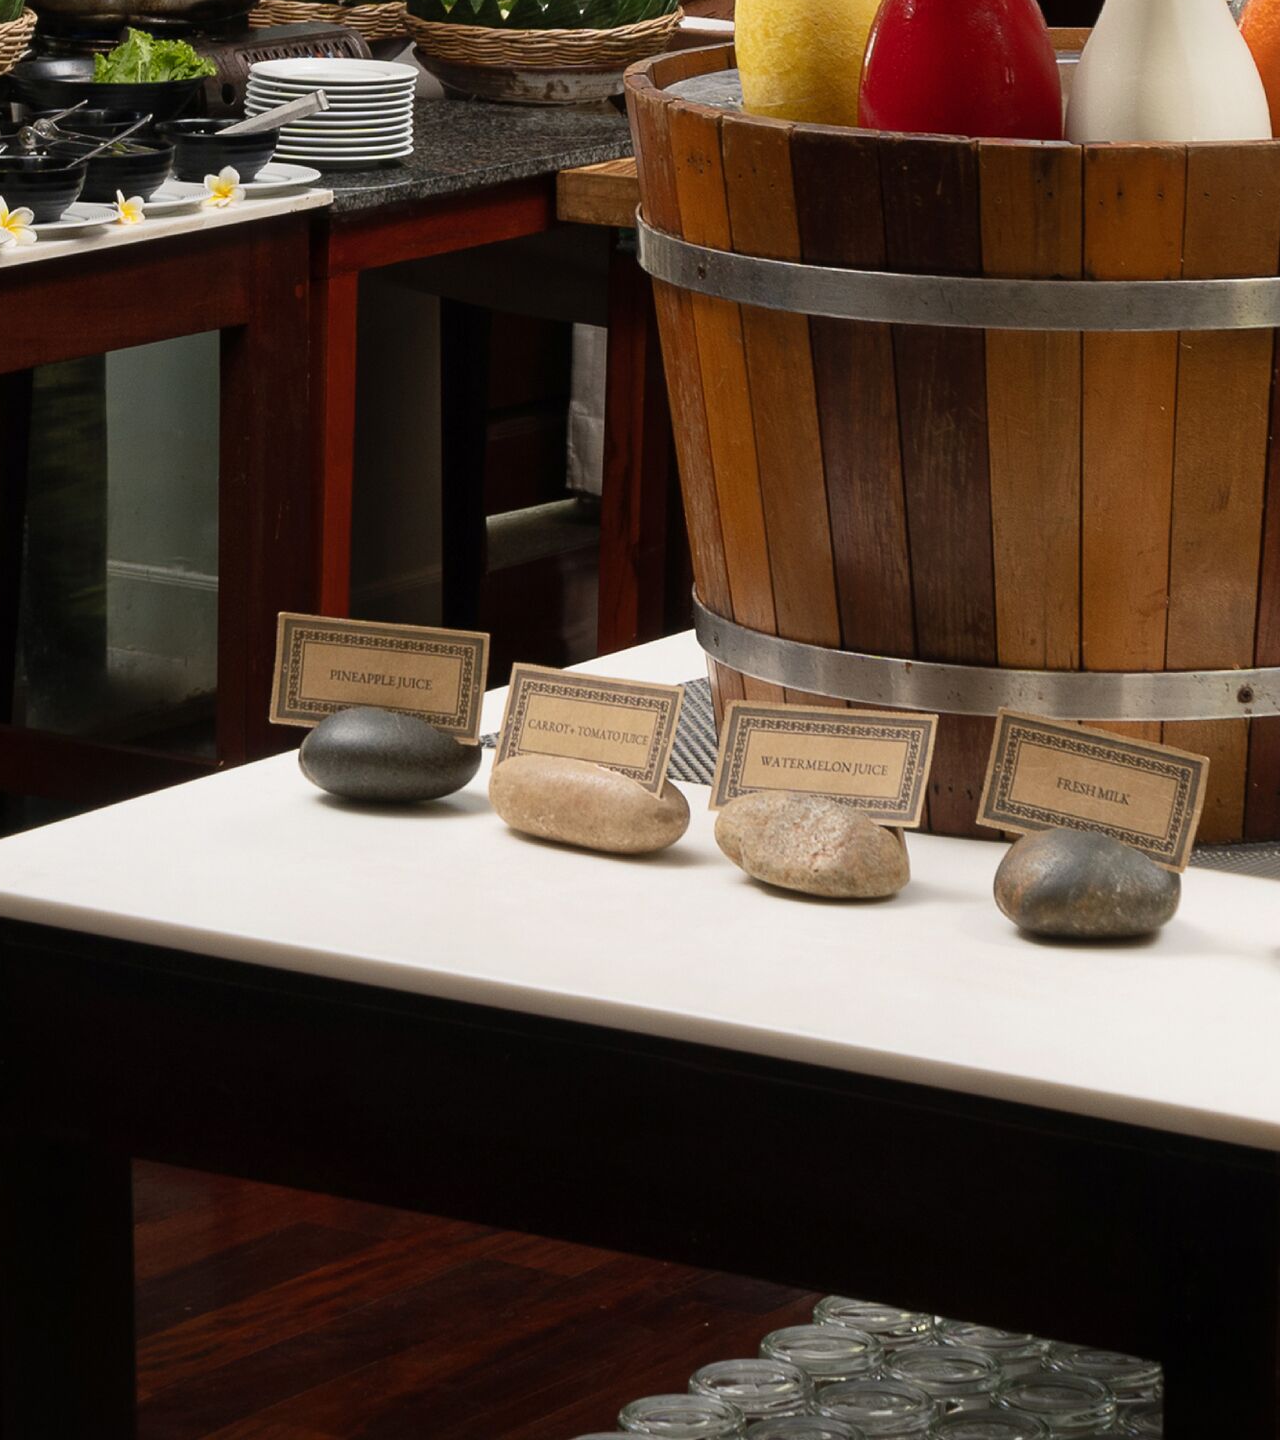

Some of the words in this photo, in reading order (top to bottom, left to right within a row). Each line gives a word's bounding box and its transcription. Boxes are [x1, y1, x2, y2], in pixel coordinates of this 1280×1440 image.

[329, 669, 395, 686] PINEAPPLE
[396, 676, 432, 690] JUICE
[528, 719, 569, 734] CARROT
[578, 726, 620, 742] TOMATO
[620, 732, 648, 745] JUICE
[761, 755, 851, 773] WATERMELON
[851, 762, 888, 776] JUICE
[1057, 777, 1096, 797] FRESH
[1096, 787, 1131, 805] MILK
